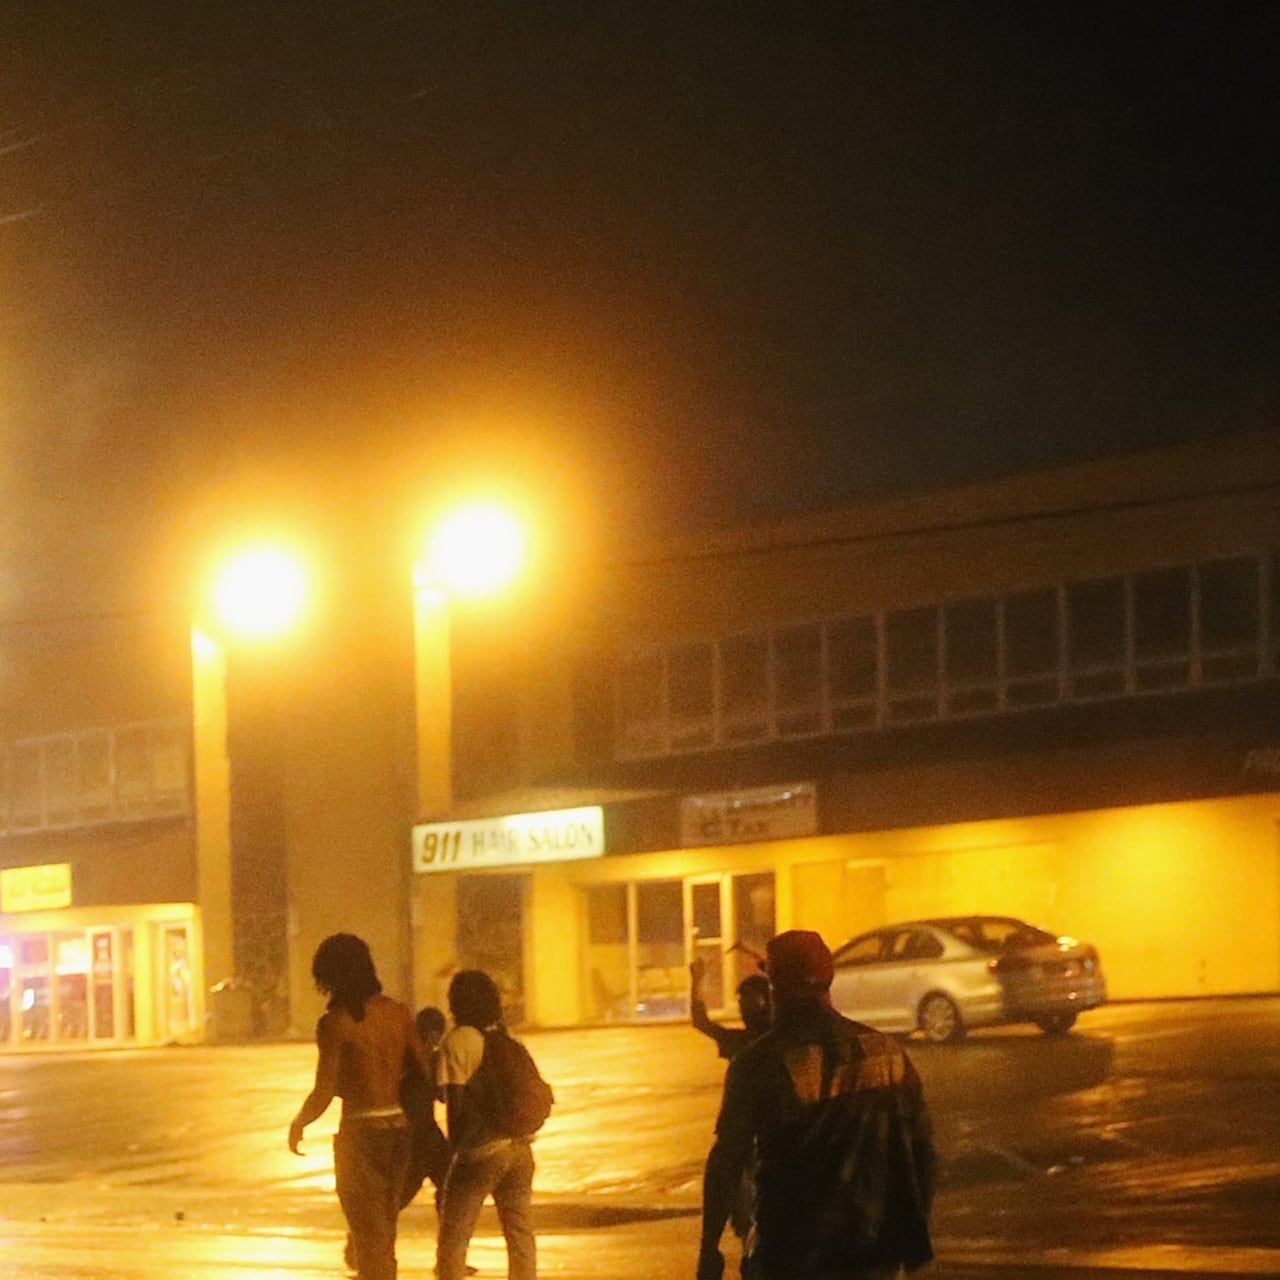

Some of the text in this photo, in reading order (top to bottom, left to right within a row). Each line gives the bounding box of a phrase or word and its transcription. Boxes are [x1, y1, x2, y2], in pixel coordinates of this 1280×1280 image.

[421, 821, 594, 864] 911 HAIR SALON
